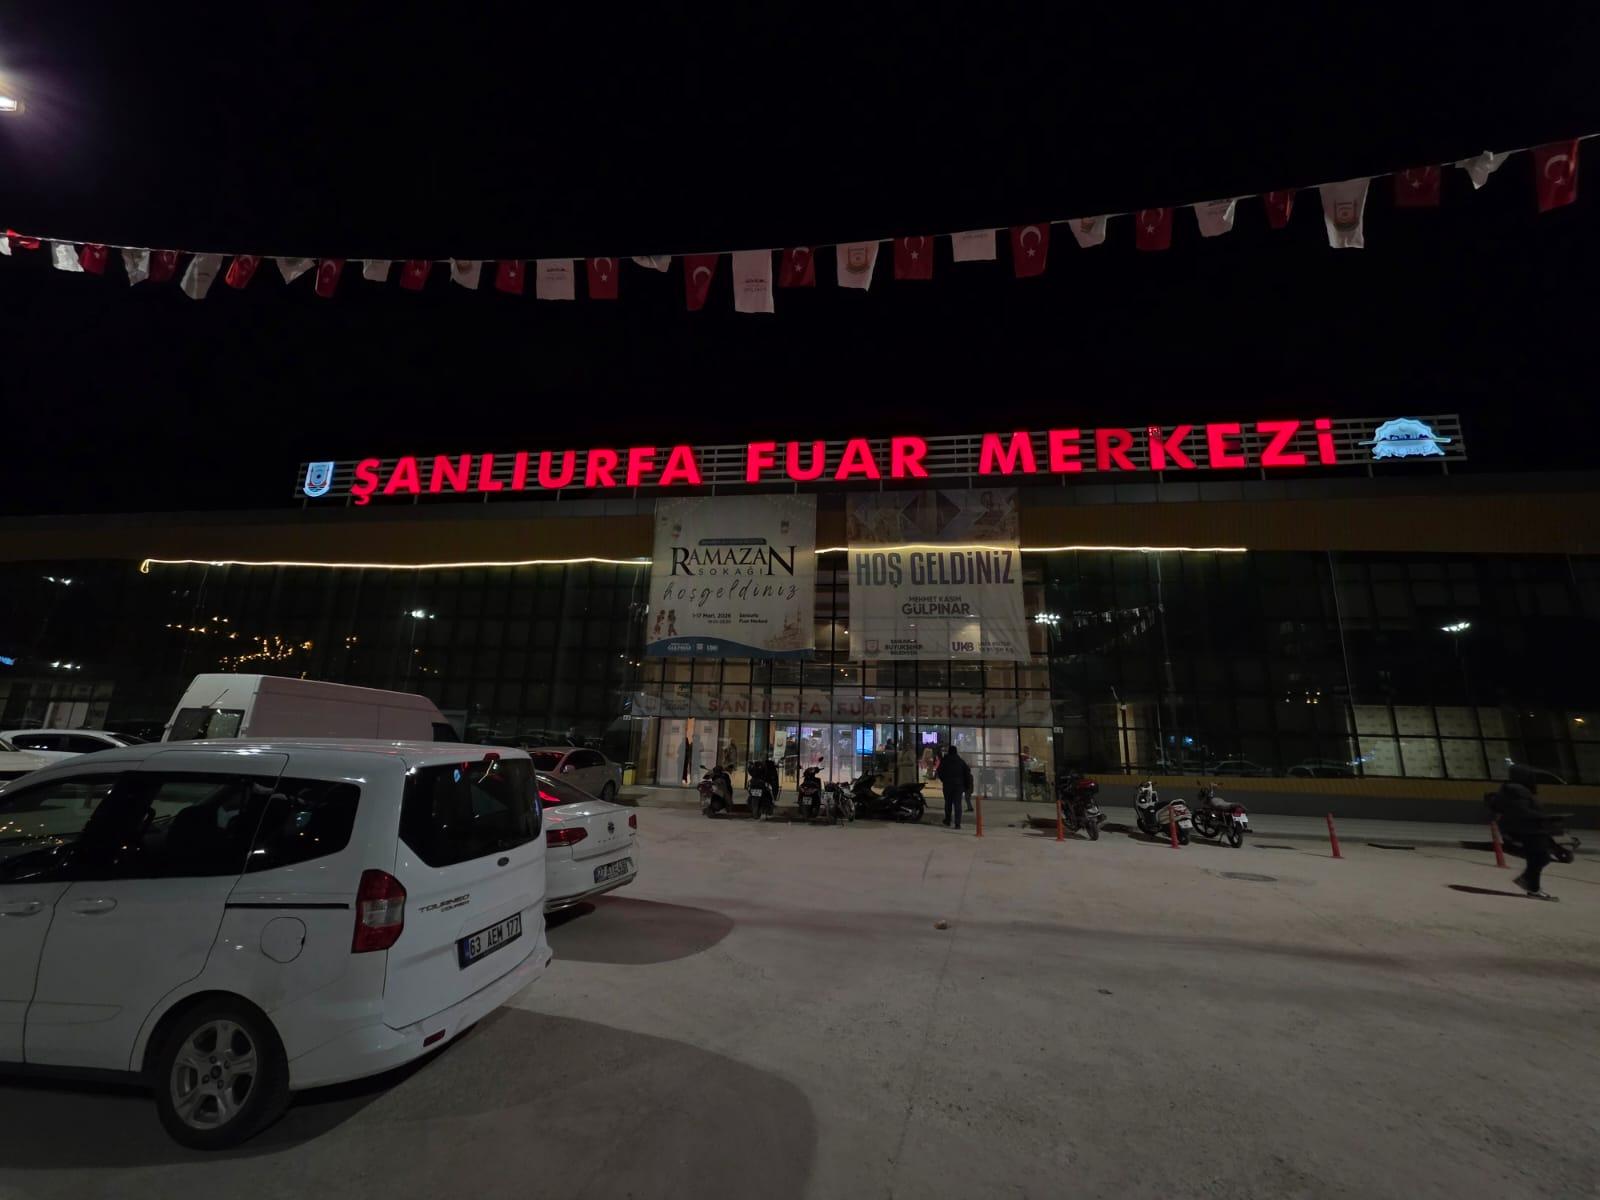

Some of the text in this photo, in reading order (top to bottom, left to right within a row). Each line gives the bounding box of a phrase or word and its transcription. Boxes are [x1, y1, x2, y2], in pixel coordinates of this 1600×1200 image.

[351, 445, 702, 506] ŞANLIURFA
[745, 435, 929, 484] FUAR
[670, 545, 798, 577] RAMAZAN
[856, 552, 902, 588] HOŞ
[902, 603, 970, 615] GÜLPINAR
[951, 641, 975, 652] UKB
[837, 702, 891, 717] FUAR
[470, 917, 519, 957] 63 AEM 177
